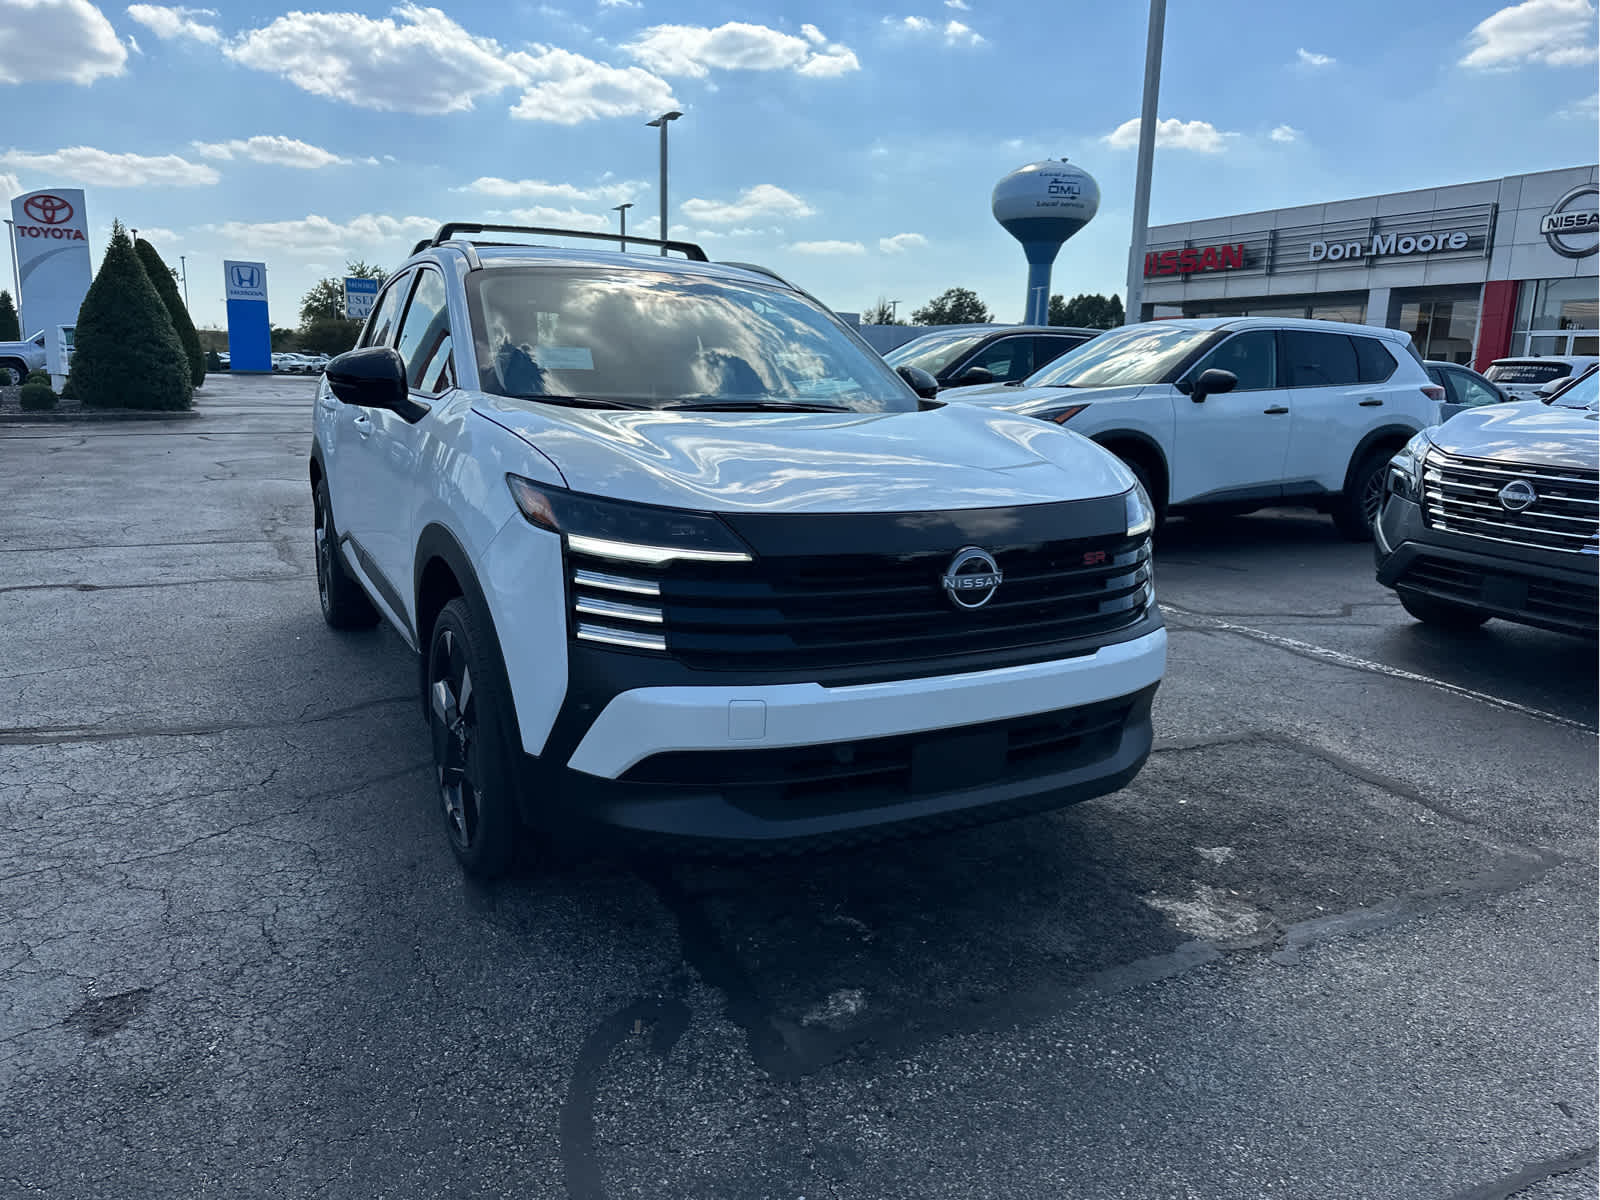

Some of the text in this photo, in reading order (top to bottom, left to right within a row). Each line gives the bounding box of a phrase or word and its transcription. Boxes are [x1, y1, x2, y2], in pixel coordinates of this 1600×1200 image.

[1036, 199, 1059, 208] Local
[17, 225, 85, 241] TOYOTA
[1308, 230, 1469, 262] Don Moore
[1083, 551, 1105, 565] SR
[943, 574, 1003, 589] NISSAN
